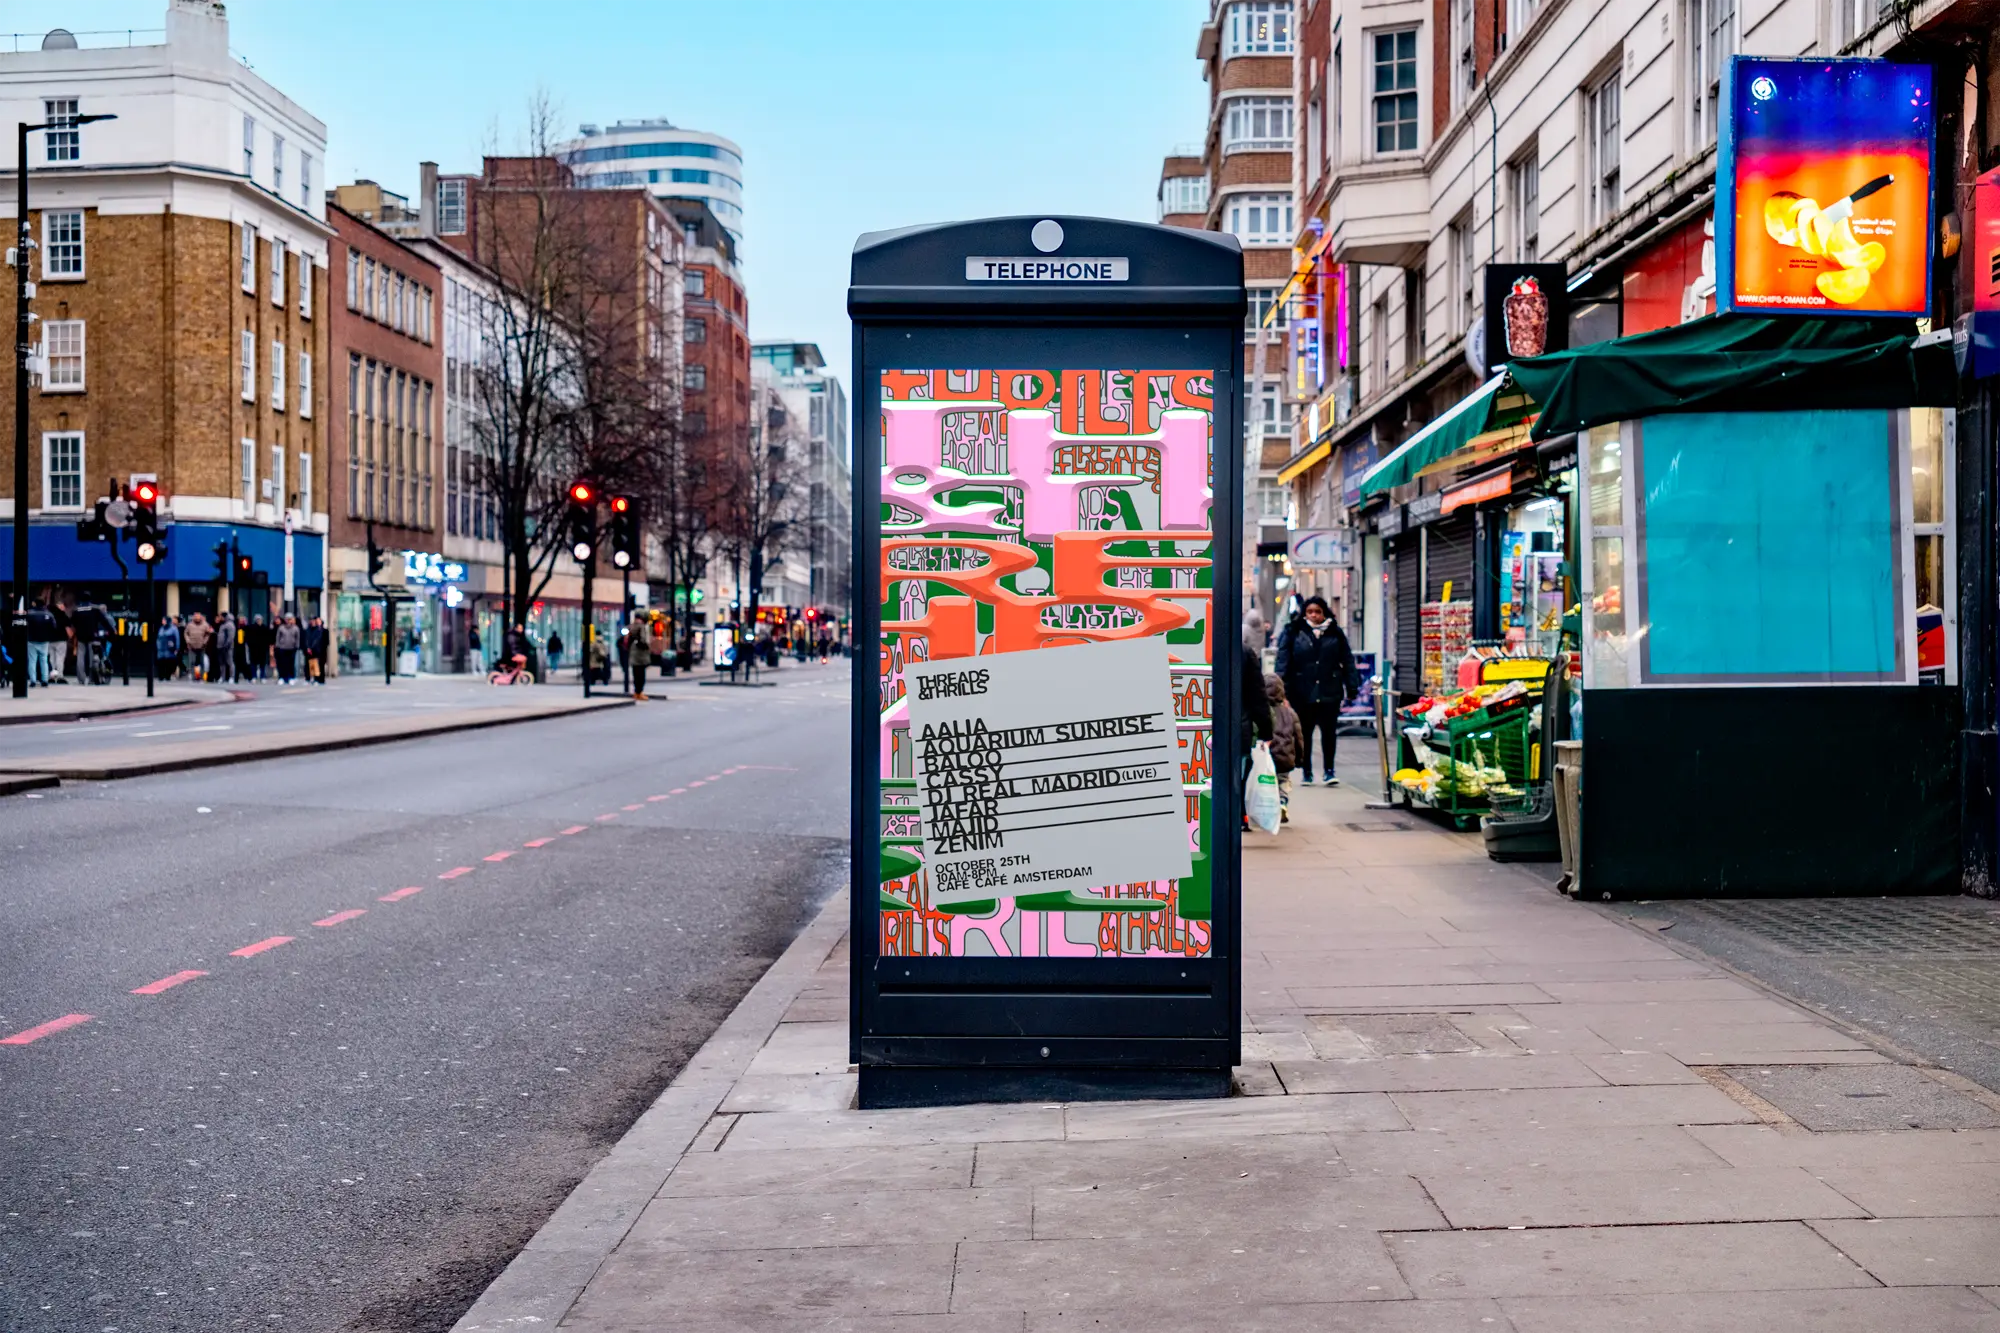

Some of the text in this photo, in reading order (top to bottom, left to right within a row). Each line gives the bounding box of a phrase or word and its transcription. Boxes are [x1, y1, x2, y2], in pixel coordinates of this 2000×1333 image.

[984, 263, 1112, 279] TELEPHONE
[1737, 295, 1826, 305] WWW.CHIPS-OMAN.COM
[916, 669, 990, 689] THREADS
[918, 680, 988, 700] &THRILLS
[921, 717, 988, 740] AALIA
[923, 714, 1155, 758] AQUARIUM SUNRISE
[925, 749, 1002, 773] BALOO
[926, 764, 1004, 789] CASSY
[963, 780, 1021, 803] REAL
[1032, 768, 1120, 795] MADRID
[1121, 767, 1157, 781] (LIVE)
[931, 799, 999, 822] JAFAR
[932, 815, 998, 841] MAJID
[934, 831, 1004, 855] ZENIM
[935, 854, 1031, 873] OCTOBER 25TH
[936, 867, 998, 883] 10AM-8PM
[975, 873, 1009, 888] CAFÉ
[1013, 866, 1093, 885] AMSTERDAM
